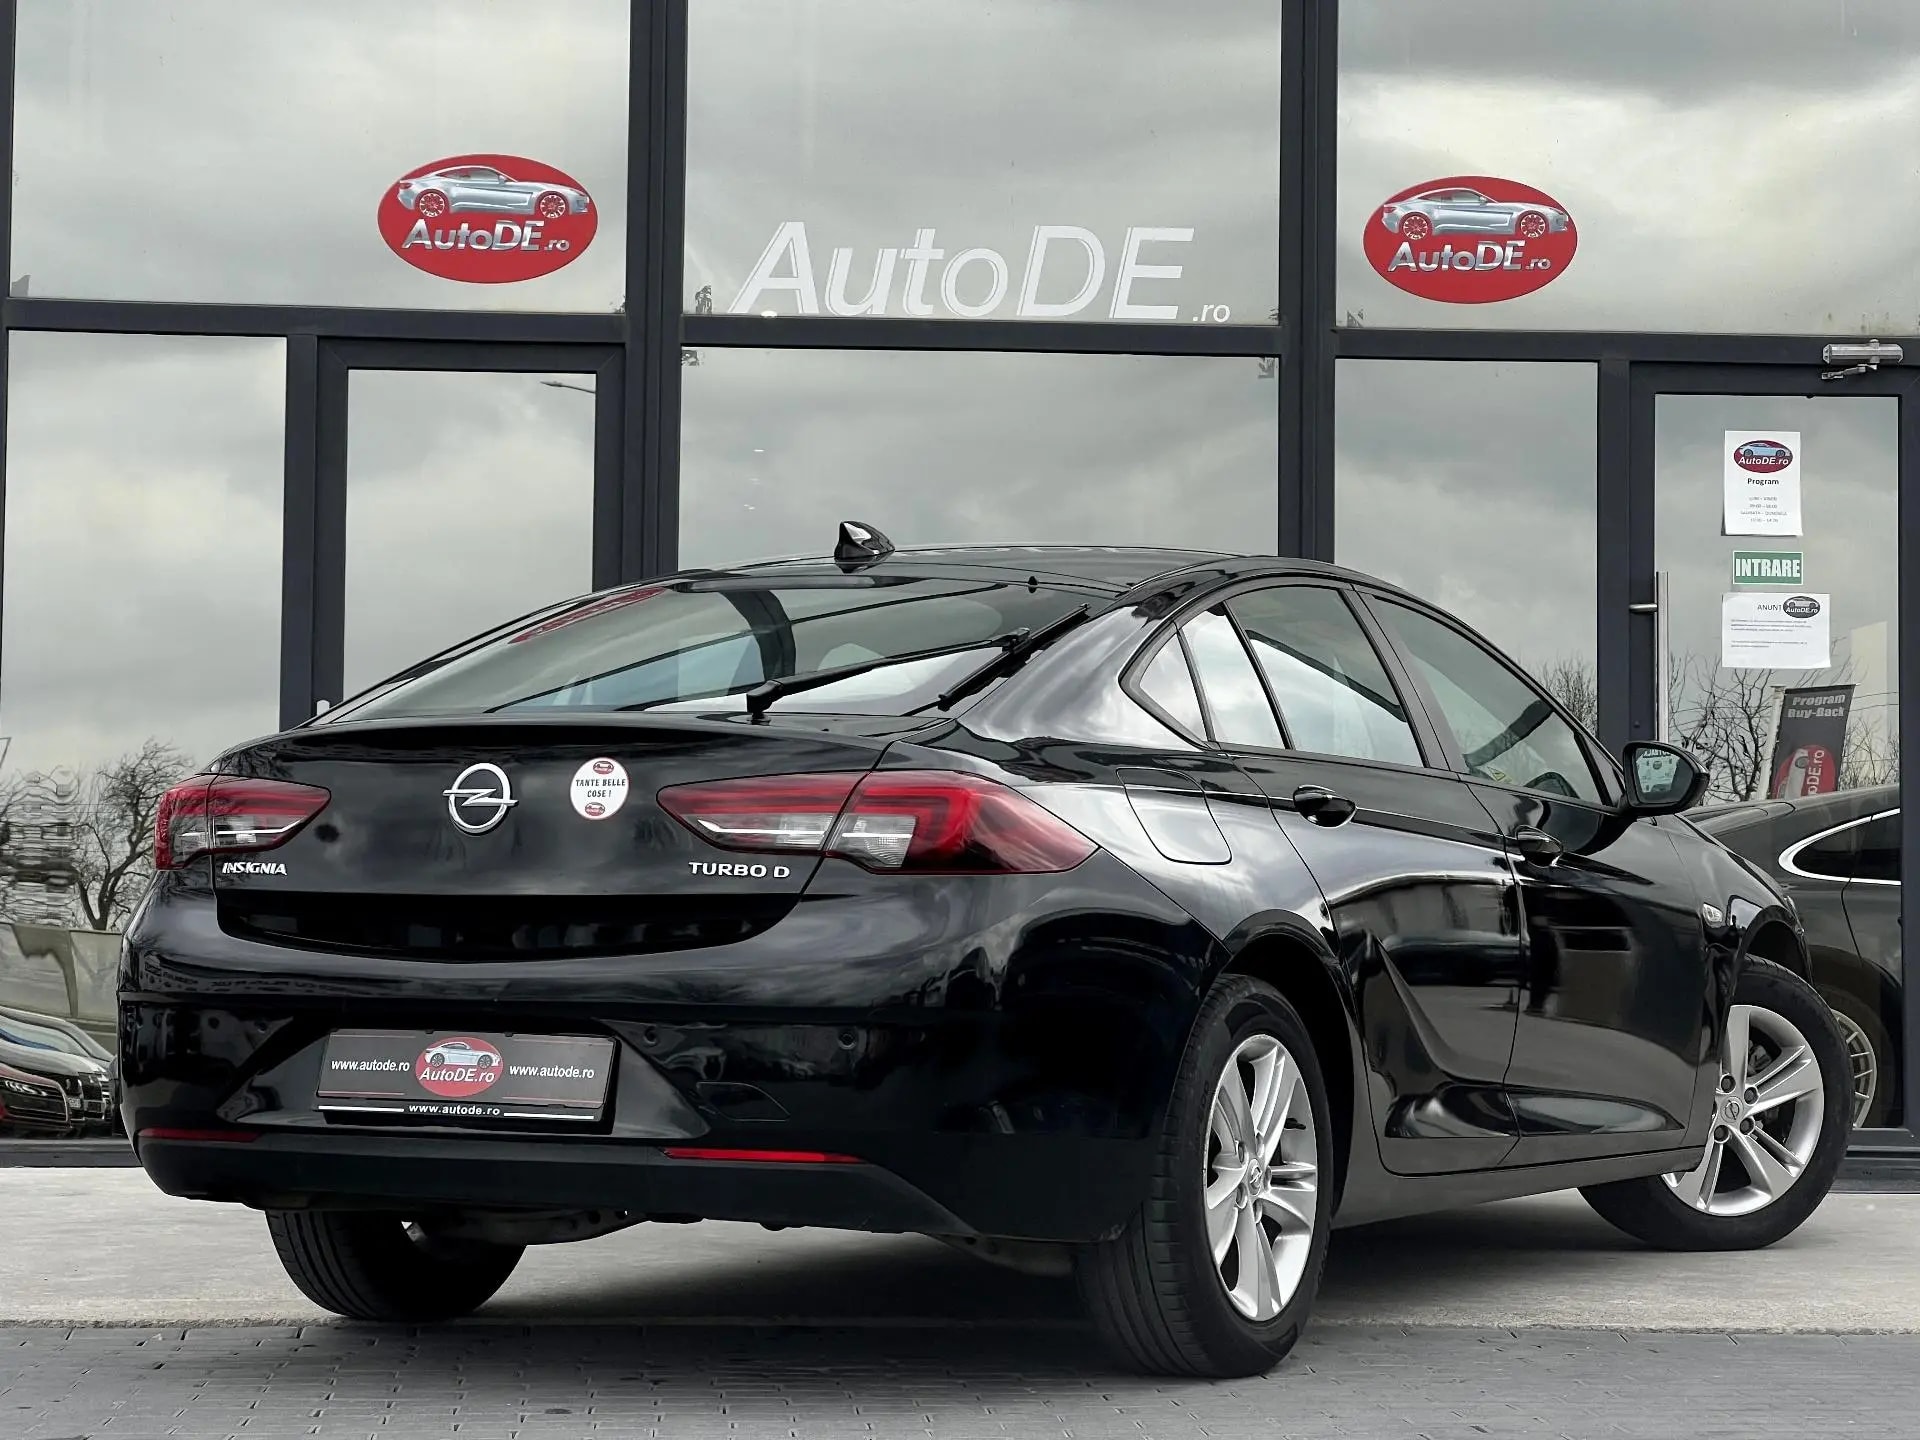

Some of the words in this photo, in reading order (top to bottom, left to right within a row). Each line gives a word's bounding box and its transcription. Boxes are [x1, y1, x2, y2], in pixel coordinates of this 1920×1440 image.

[401, 218, 570, 252] AutoDE.ro
[1387, 239, 1552, 273] AutoDE.ro
[1738, 456, 1789, 465] AutoDE.ro
[1747, 477, 1780, 486] Program
[1735, 558, 1801, 578] INTRARE
[1792, 694, 1846, 706] Program
[1787, 706, 1844, 719] Buy-Back
[1807, 750, 1825, 795] oDE.ro
[575, 779, 600, 787] TANTE
[602, 778, 626, 787] BELLE
[587, 790, 607, 798] COSE
[222, 862, 288, 876] INSIGNIA
[688, 862, 767, 878] TURBO
[773, 866, 790, 878] D
[331, 1059, 410, 1072] www.autode.ro
[418, 1067, 495, 1083] AutoDE.ro
[509, 1064, 595, 1079] www.autode.ro
[408, 1104, 500, 1116] www.autode.ro
